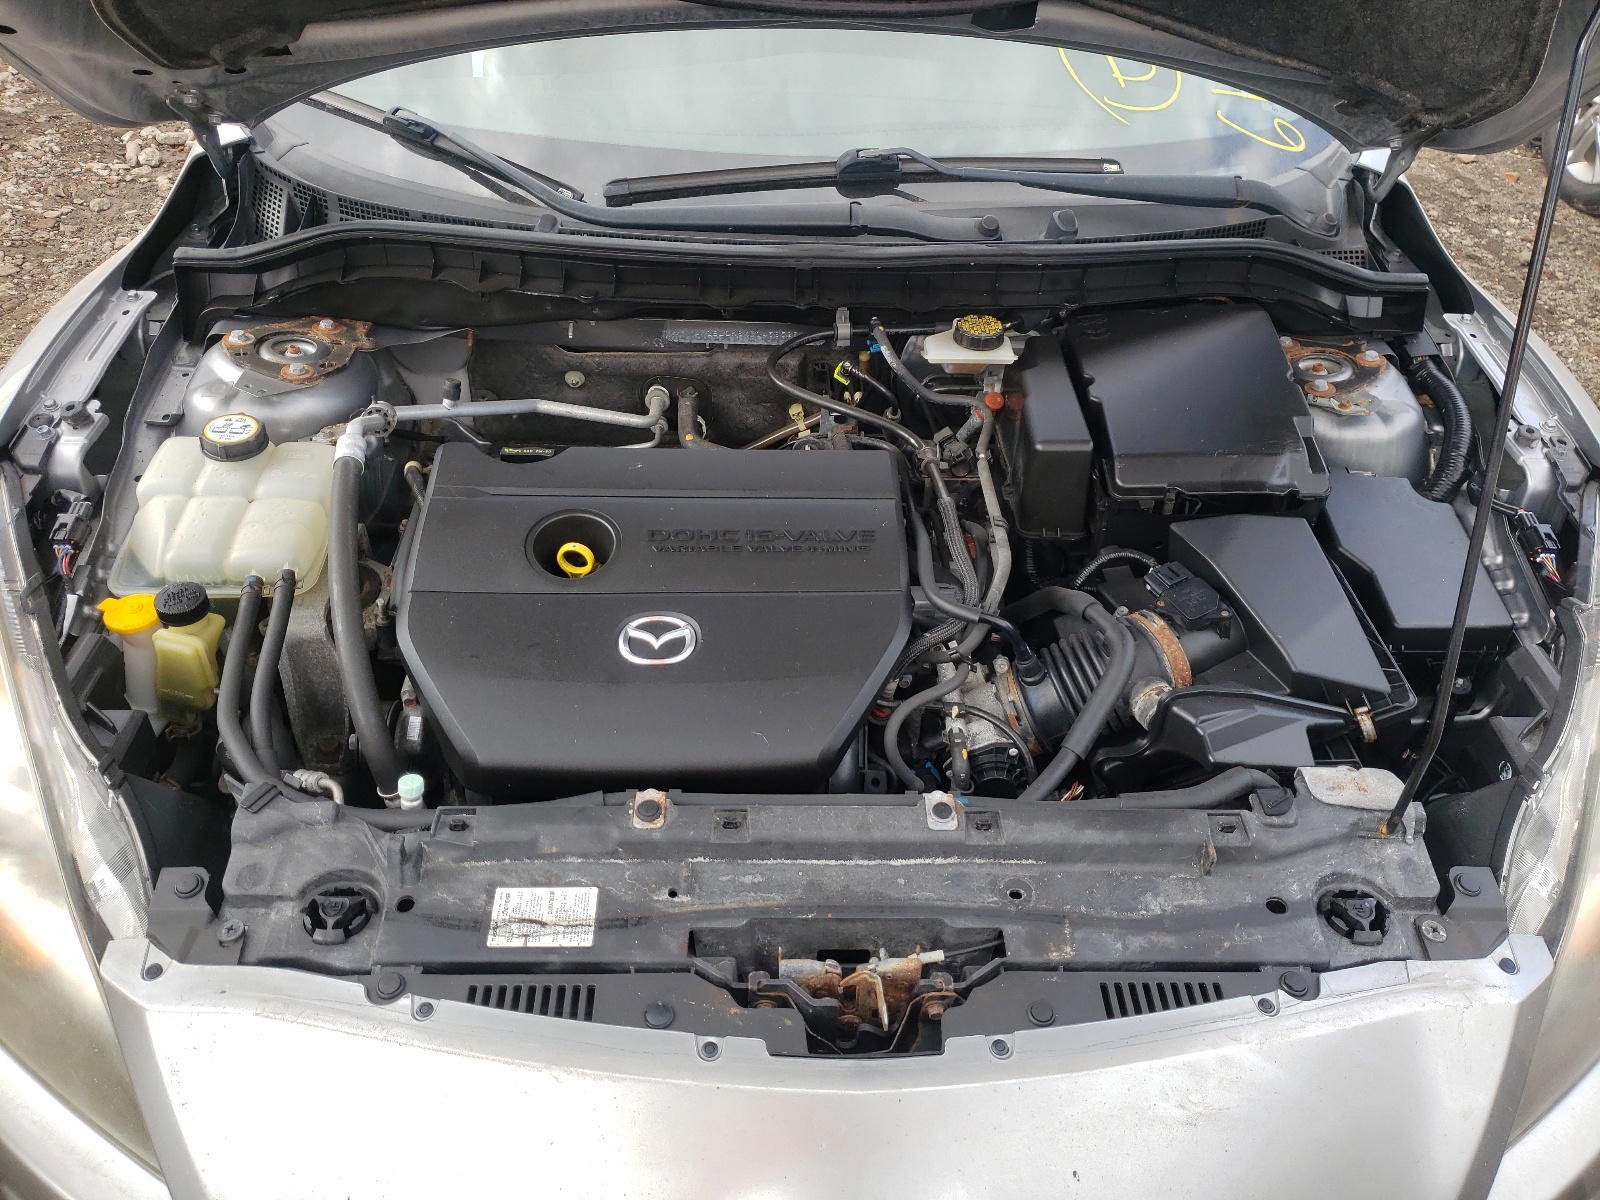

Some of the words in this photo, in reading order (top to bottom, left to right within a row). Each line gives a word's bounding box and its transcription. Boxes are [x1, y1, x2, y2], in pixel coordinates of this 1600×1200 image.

[648, 529, 741, 543] DOHC
[649, 545, 743, 553] VARIABLE
[745, 545, 802, 553] VALVE
